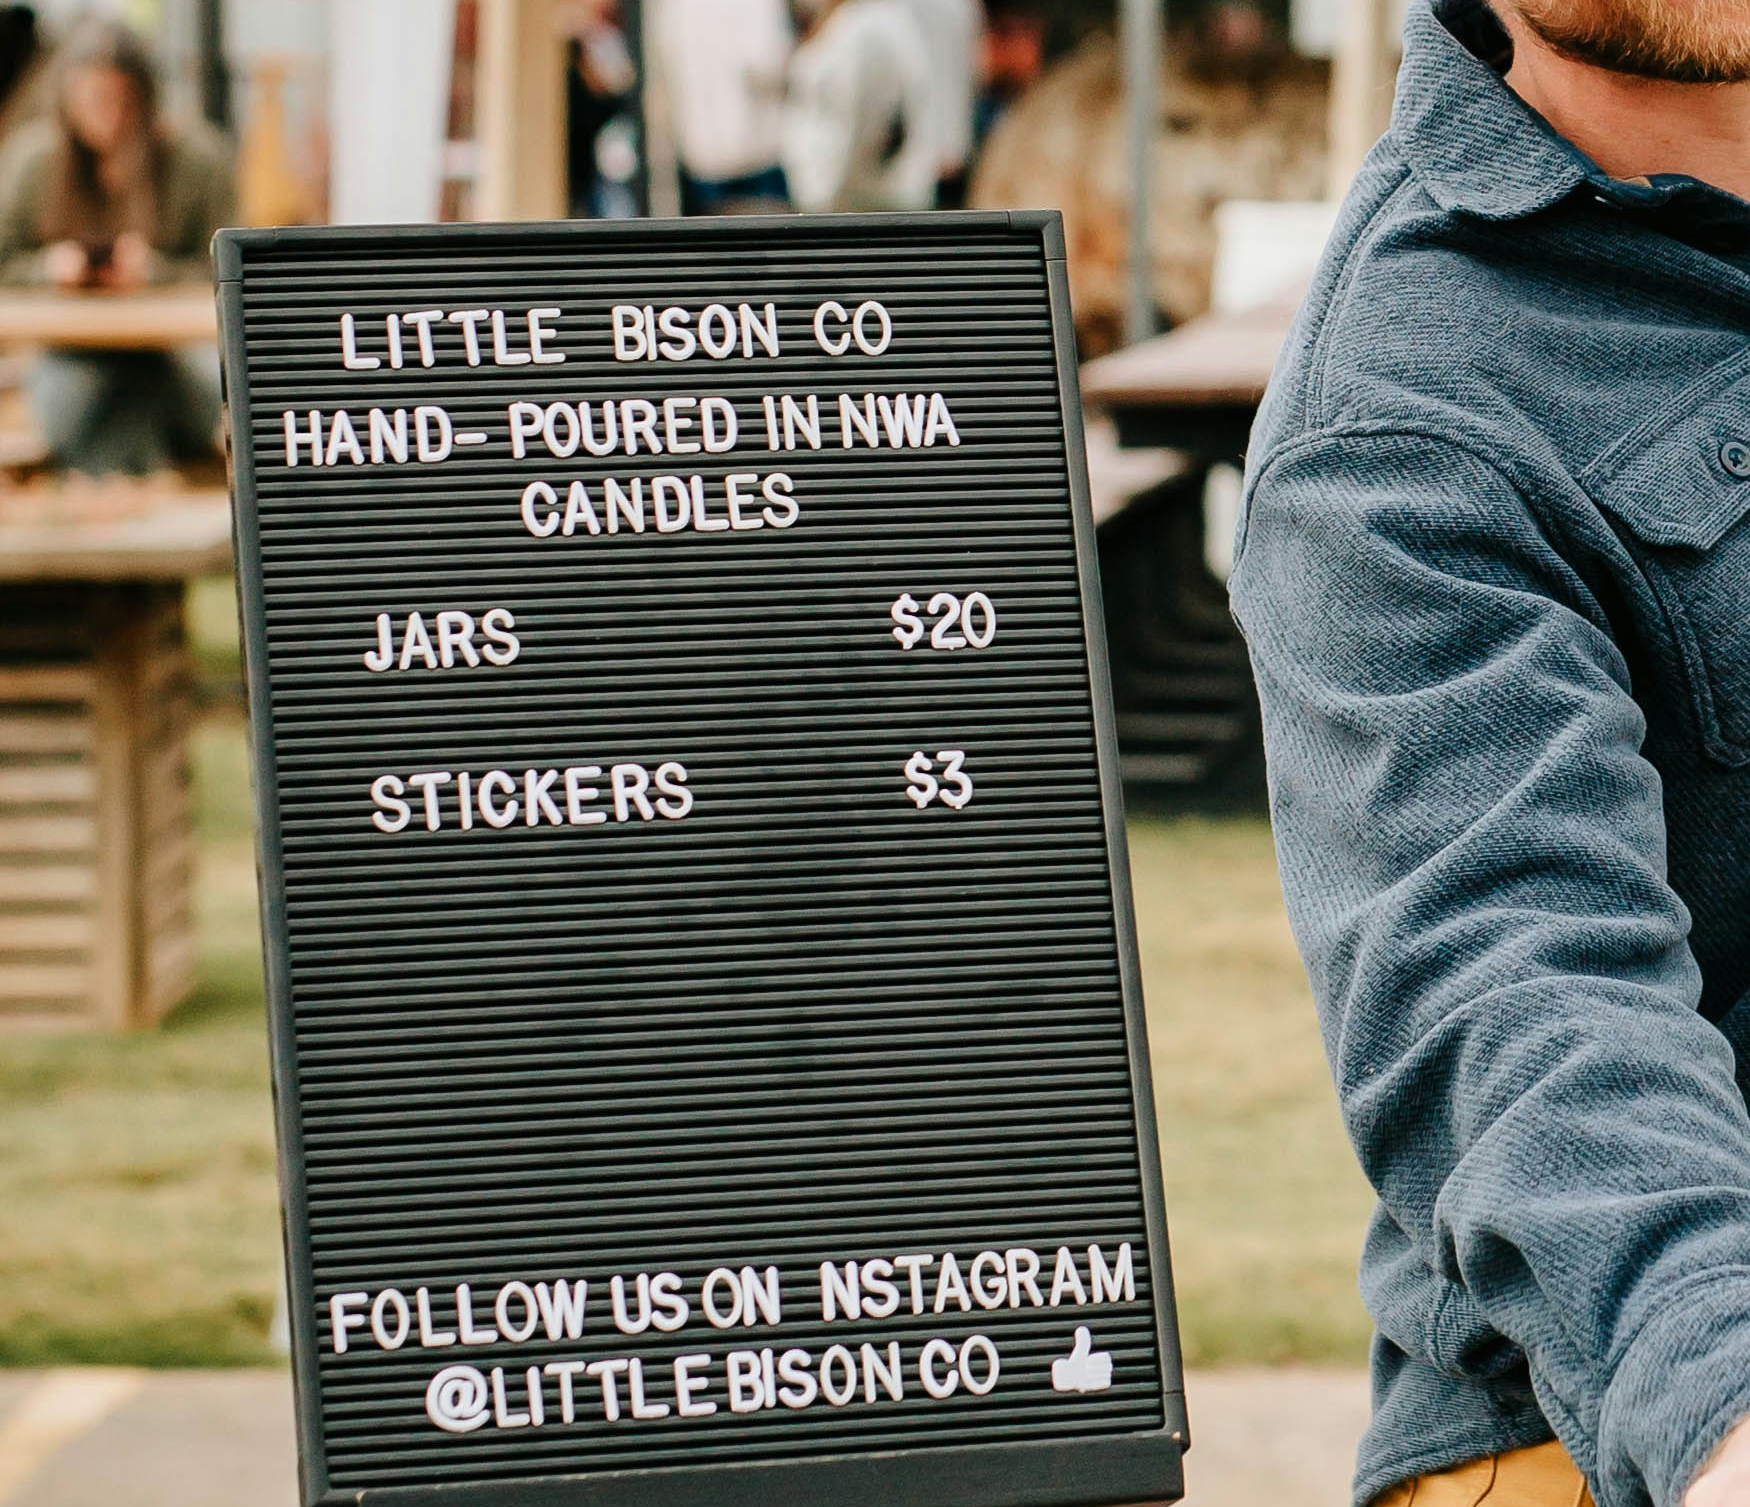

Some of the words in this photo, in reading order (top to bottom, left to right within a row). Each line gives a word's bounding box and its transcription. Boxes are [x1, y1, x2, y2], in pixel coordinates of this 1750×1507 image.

[340, 308, 566, 370] LITTLE
[612, 302, 780, 362] BISON
[813, 300, 894, 357] CO
[508, 396, 739, 460] POURED
[764, 394, 822, 453] IN
[839, 392, 961, 450] NWA
[521, 472, 801, 538] CANDLES
[363, 607, 522, 673] JARS
[891, 590, 998, 651] $20
[370, 761, 695, 834] STICKERS
[904, 749, 975, 811] $3
[330, 1278, 589, 1354] FOLLOW
[610, 1270, 690, 1336] US
[702, 1264, 782, 1329] ON
[819, 1241, 1137, 1323] NSTAGRAM
[919, 1333, 1001, 1401] CO
